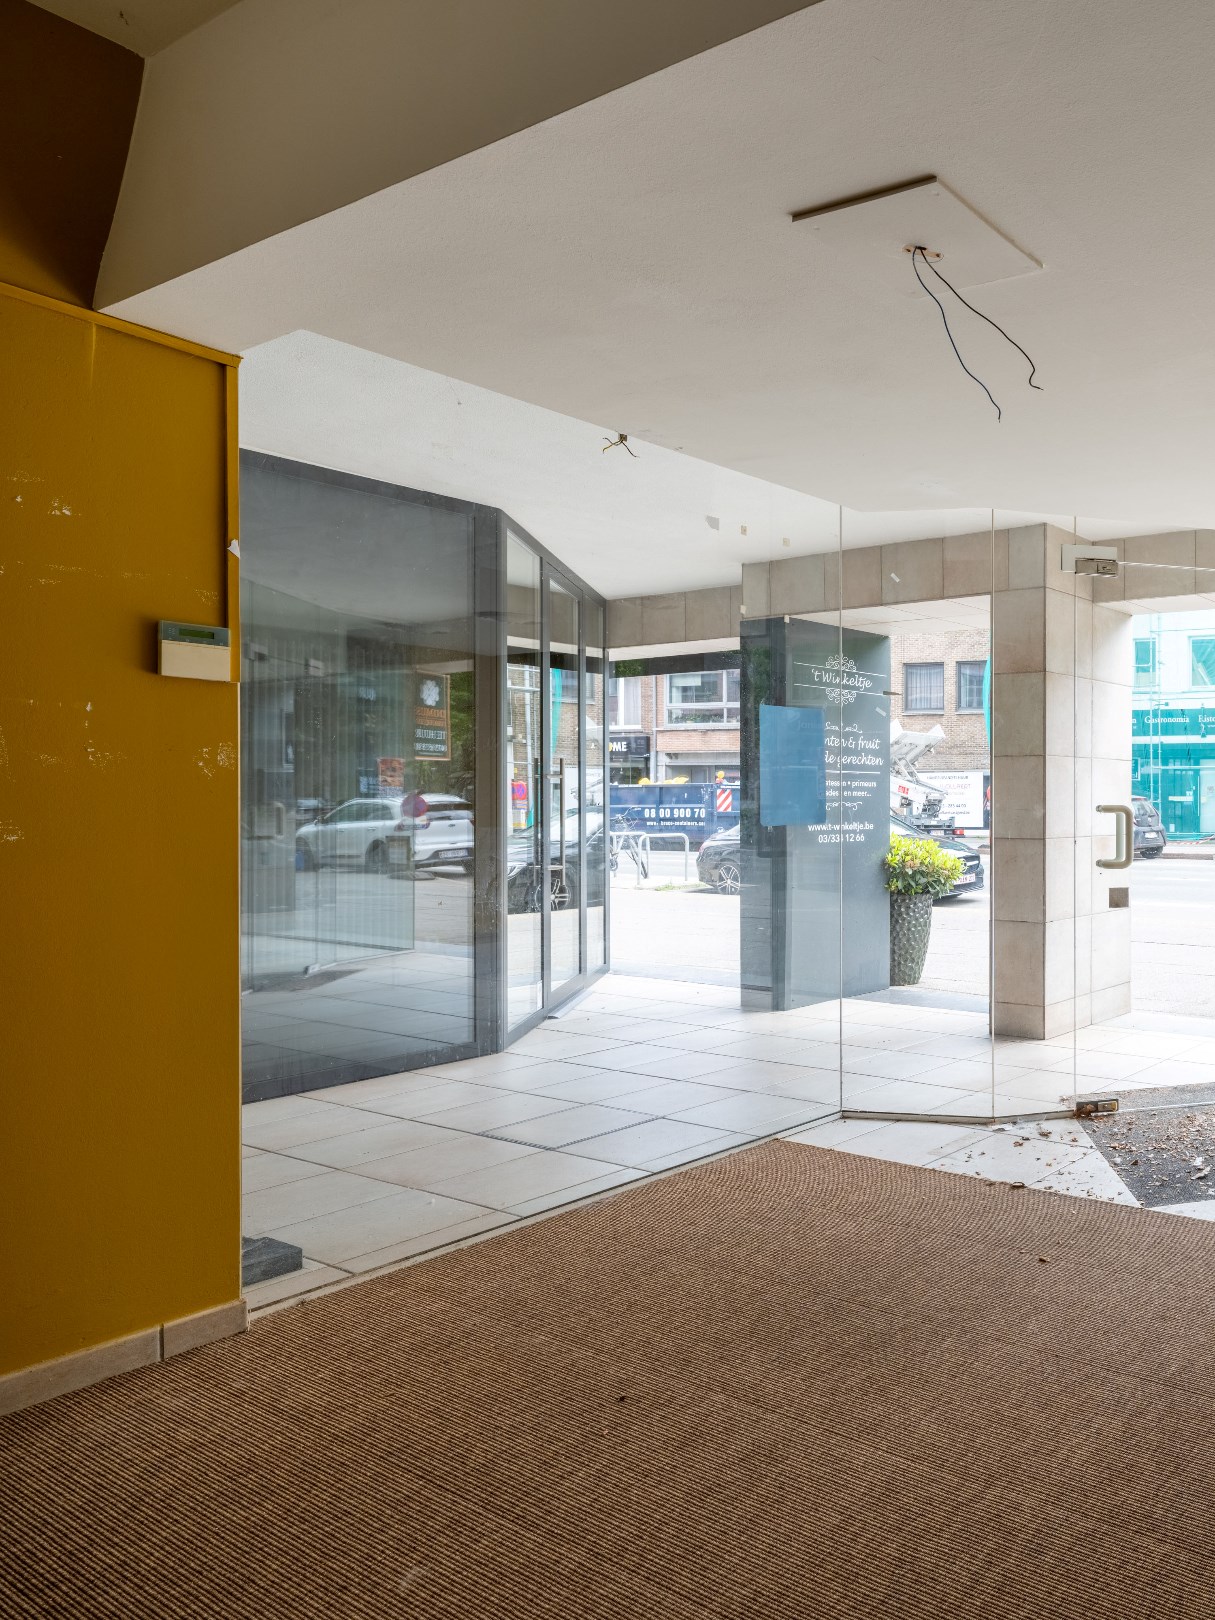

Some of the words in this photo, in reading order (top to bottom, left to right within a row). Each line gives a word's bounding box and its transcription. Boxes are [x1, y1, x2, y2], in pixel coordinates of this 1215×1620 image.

[822, 670, 873, 691] Winkeltje
[1144, 715, 1190, 724] Gastronomia
[848, 737, 855, 748] &
[858, 736, 881, 751] fruit
[836, 753, 884, 768] gerechten
[644, 808, 656, 818] 08
[659, 808, 671, 818] 00
[673, 808, 691, 818] 900
[693, 808, 706, 818] 70
[845, 834, 855, 842] 12
[855, 833, 865, 842] 66
